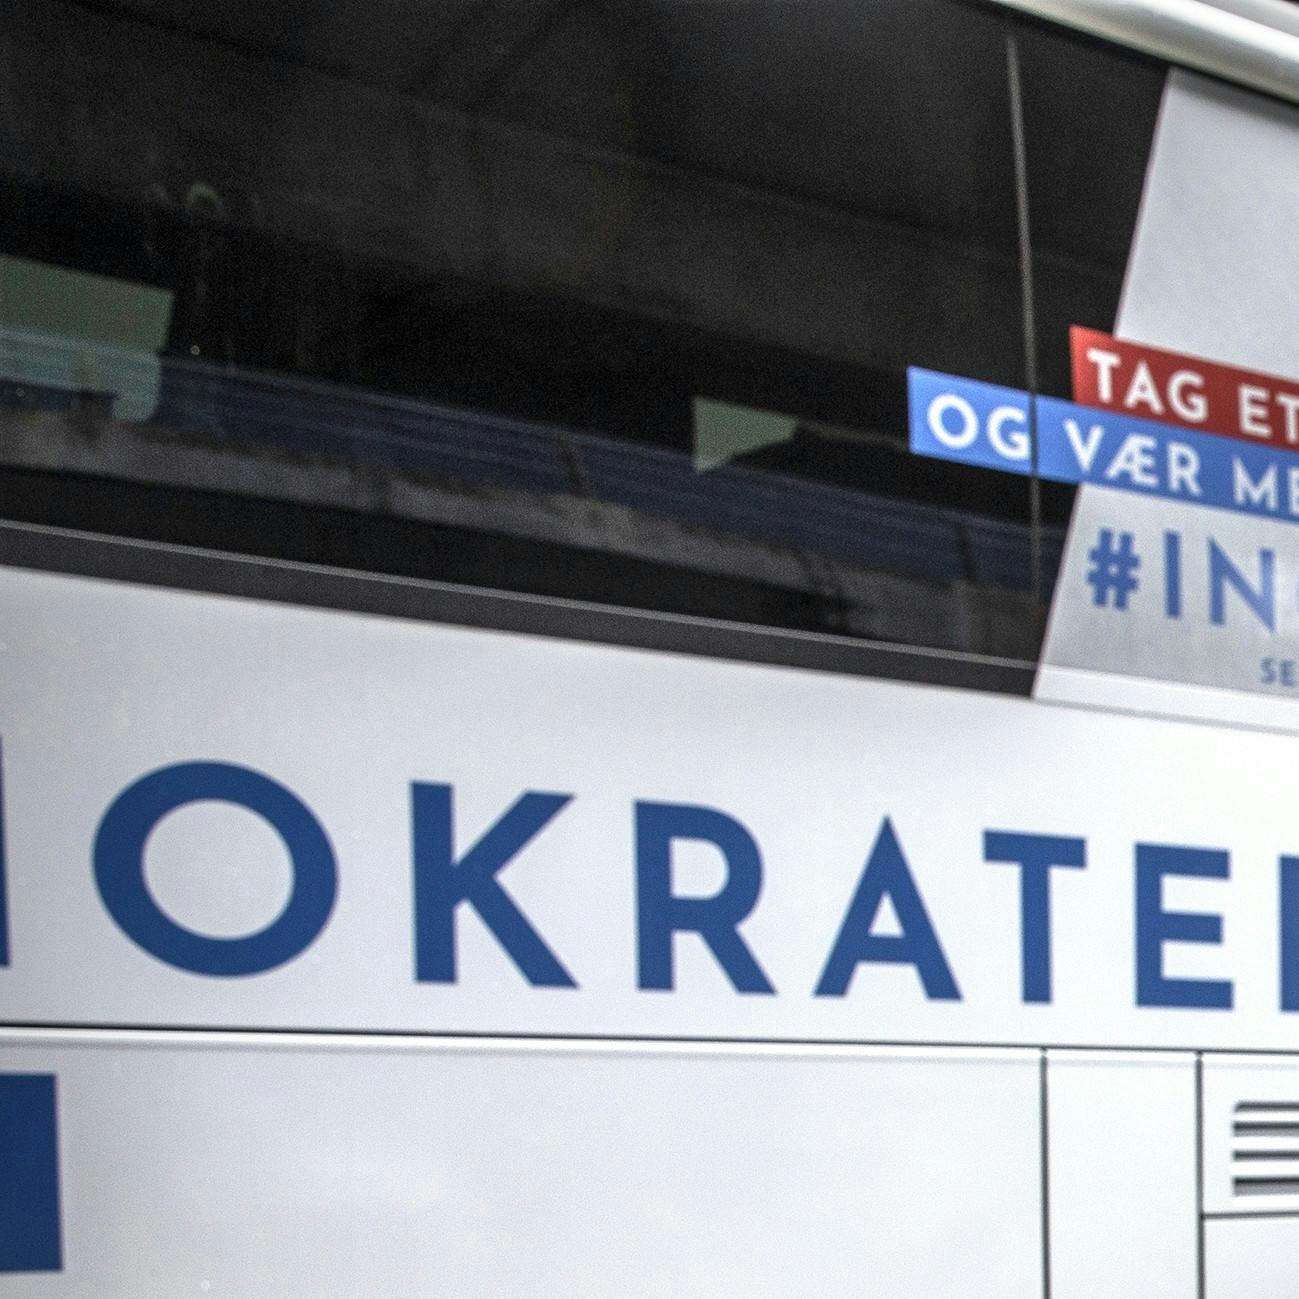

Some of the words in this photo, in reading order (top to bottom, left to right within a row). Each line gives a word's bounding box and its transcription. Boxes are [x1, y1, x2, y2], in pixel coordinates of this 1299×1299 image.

[1086, 347, 1209, 422] TAG
[926, 392, 1032, 460] OG
[1062, 418, 1203, 497] VÆR
[1260, 656, 1296, 688] SE
